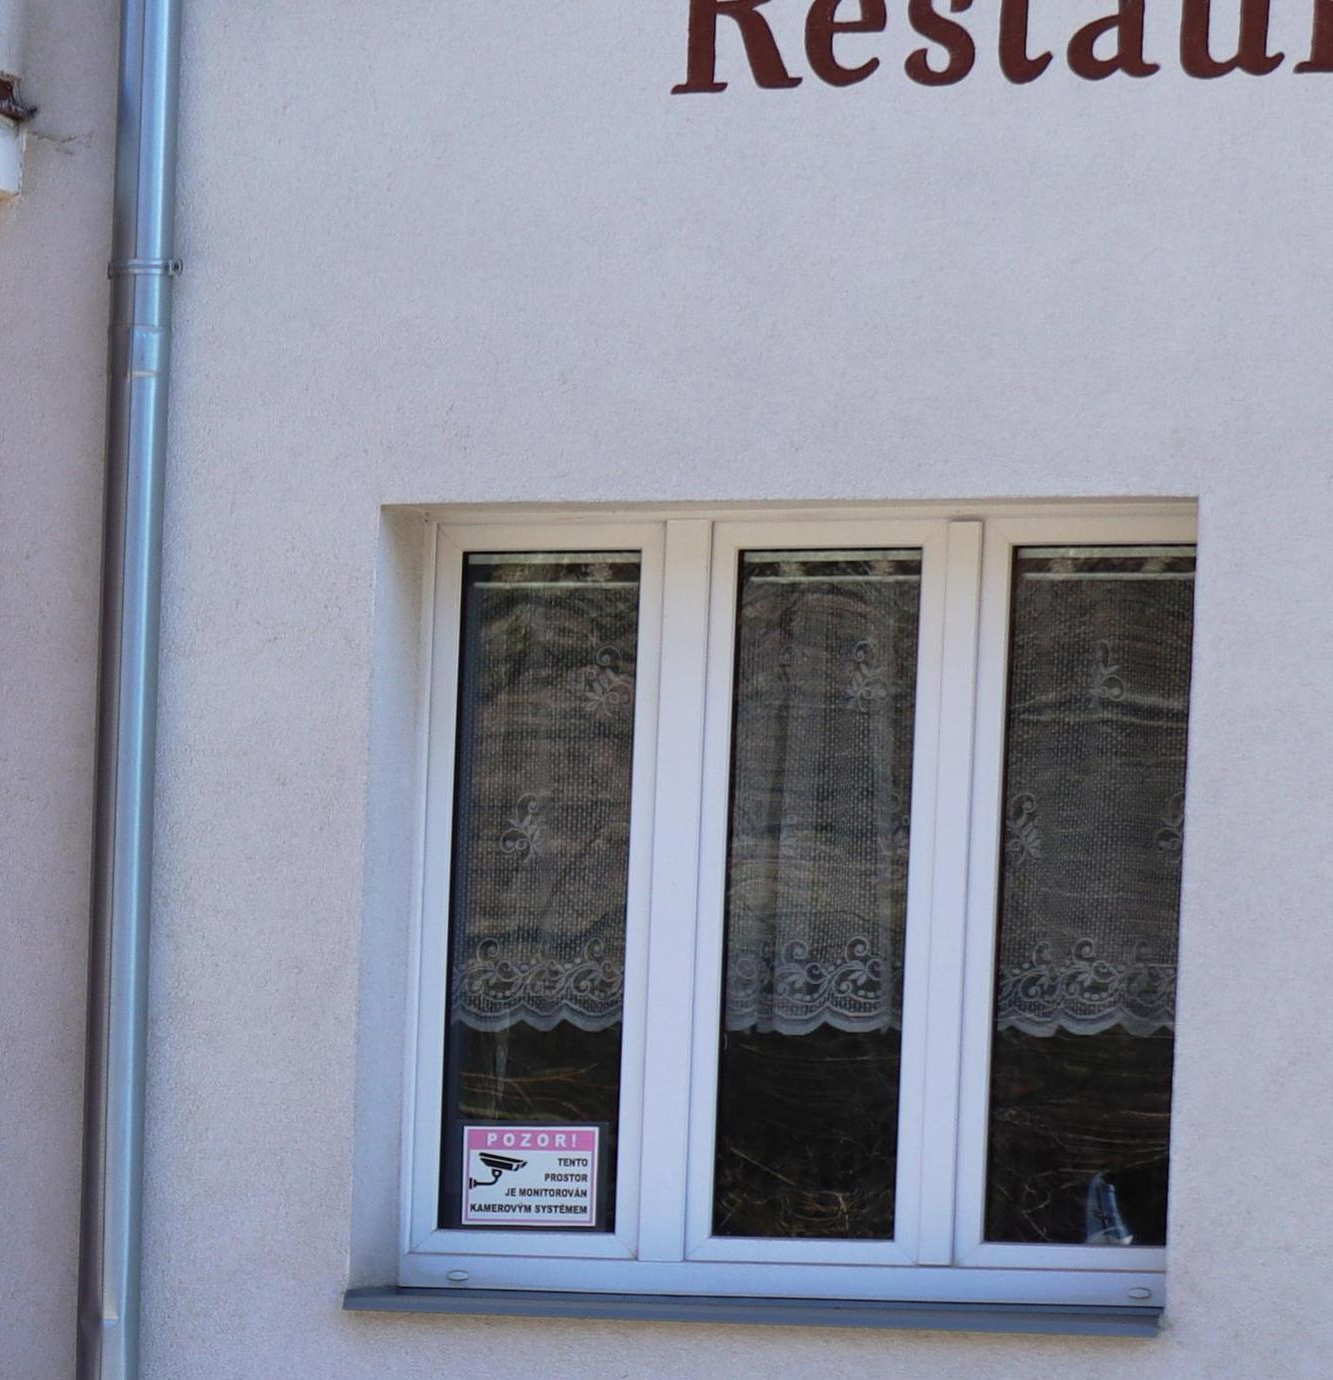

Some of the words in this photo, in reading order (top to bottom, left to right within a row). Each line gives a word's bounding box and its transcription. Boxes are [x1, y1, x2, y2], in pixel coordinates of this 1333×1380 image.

[486, 1133, 578, 1148] POZOR!
[558, 1158, 588, 1167] TENTO
[544, 1173, 588, 1182] PROSTOR
[505, 1188, 516, 1197] JE
[519, 1187, 587, 1198] MONITOROVÁN
[469, 1202, 532, 1213] KAMEROVÝM
[534, 1203, 588, 1214] SYSTÉMEM
